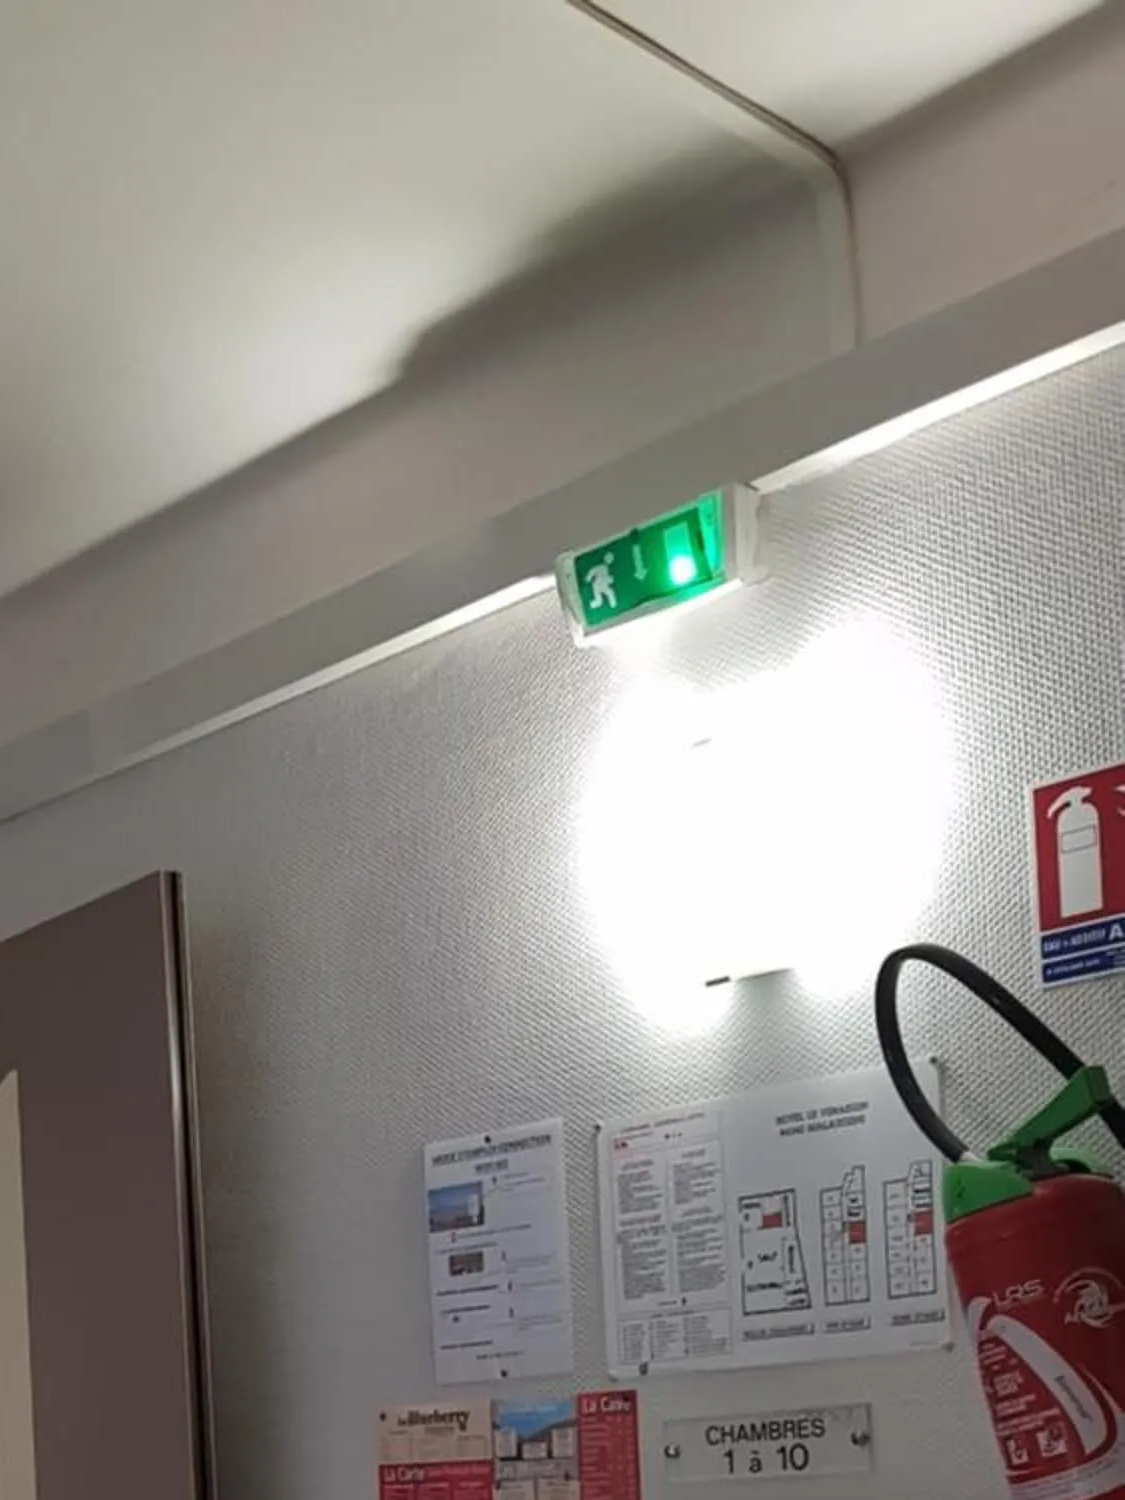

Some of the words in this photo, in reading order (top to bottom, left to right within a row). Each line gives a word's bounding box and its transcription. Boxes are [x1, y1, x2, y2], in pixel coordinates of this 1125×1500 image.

[705, 1418, 826, 1446] CHAMBRES
[723, 1449, 735, 1474] 1
[749, 1449, 763, 1474] à
[776, 1443, 810, 1471] 10
